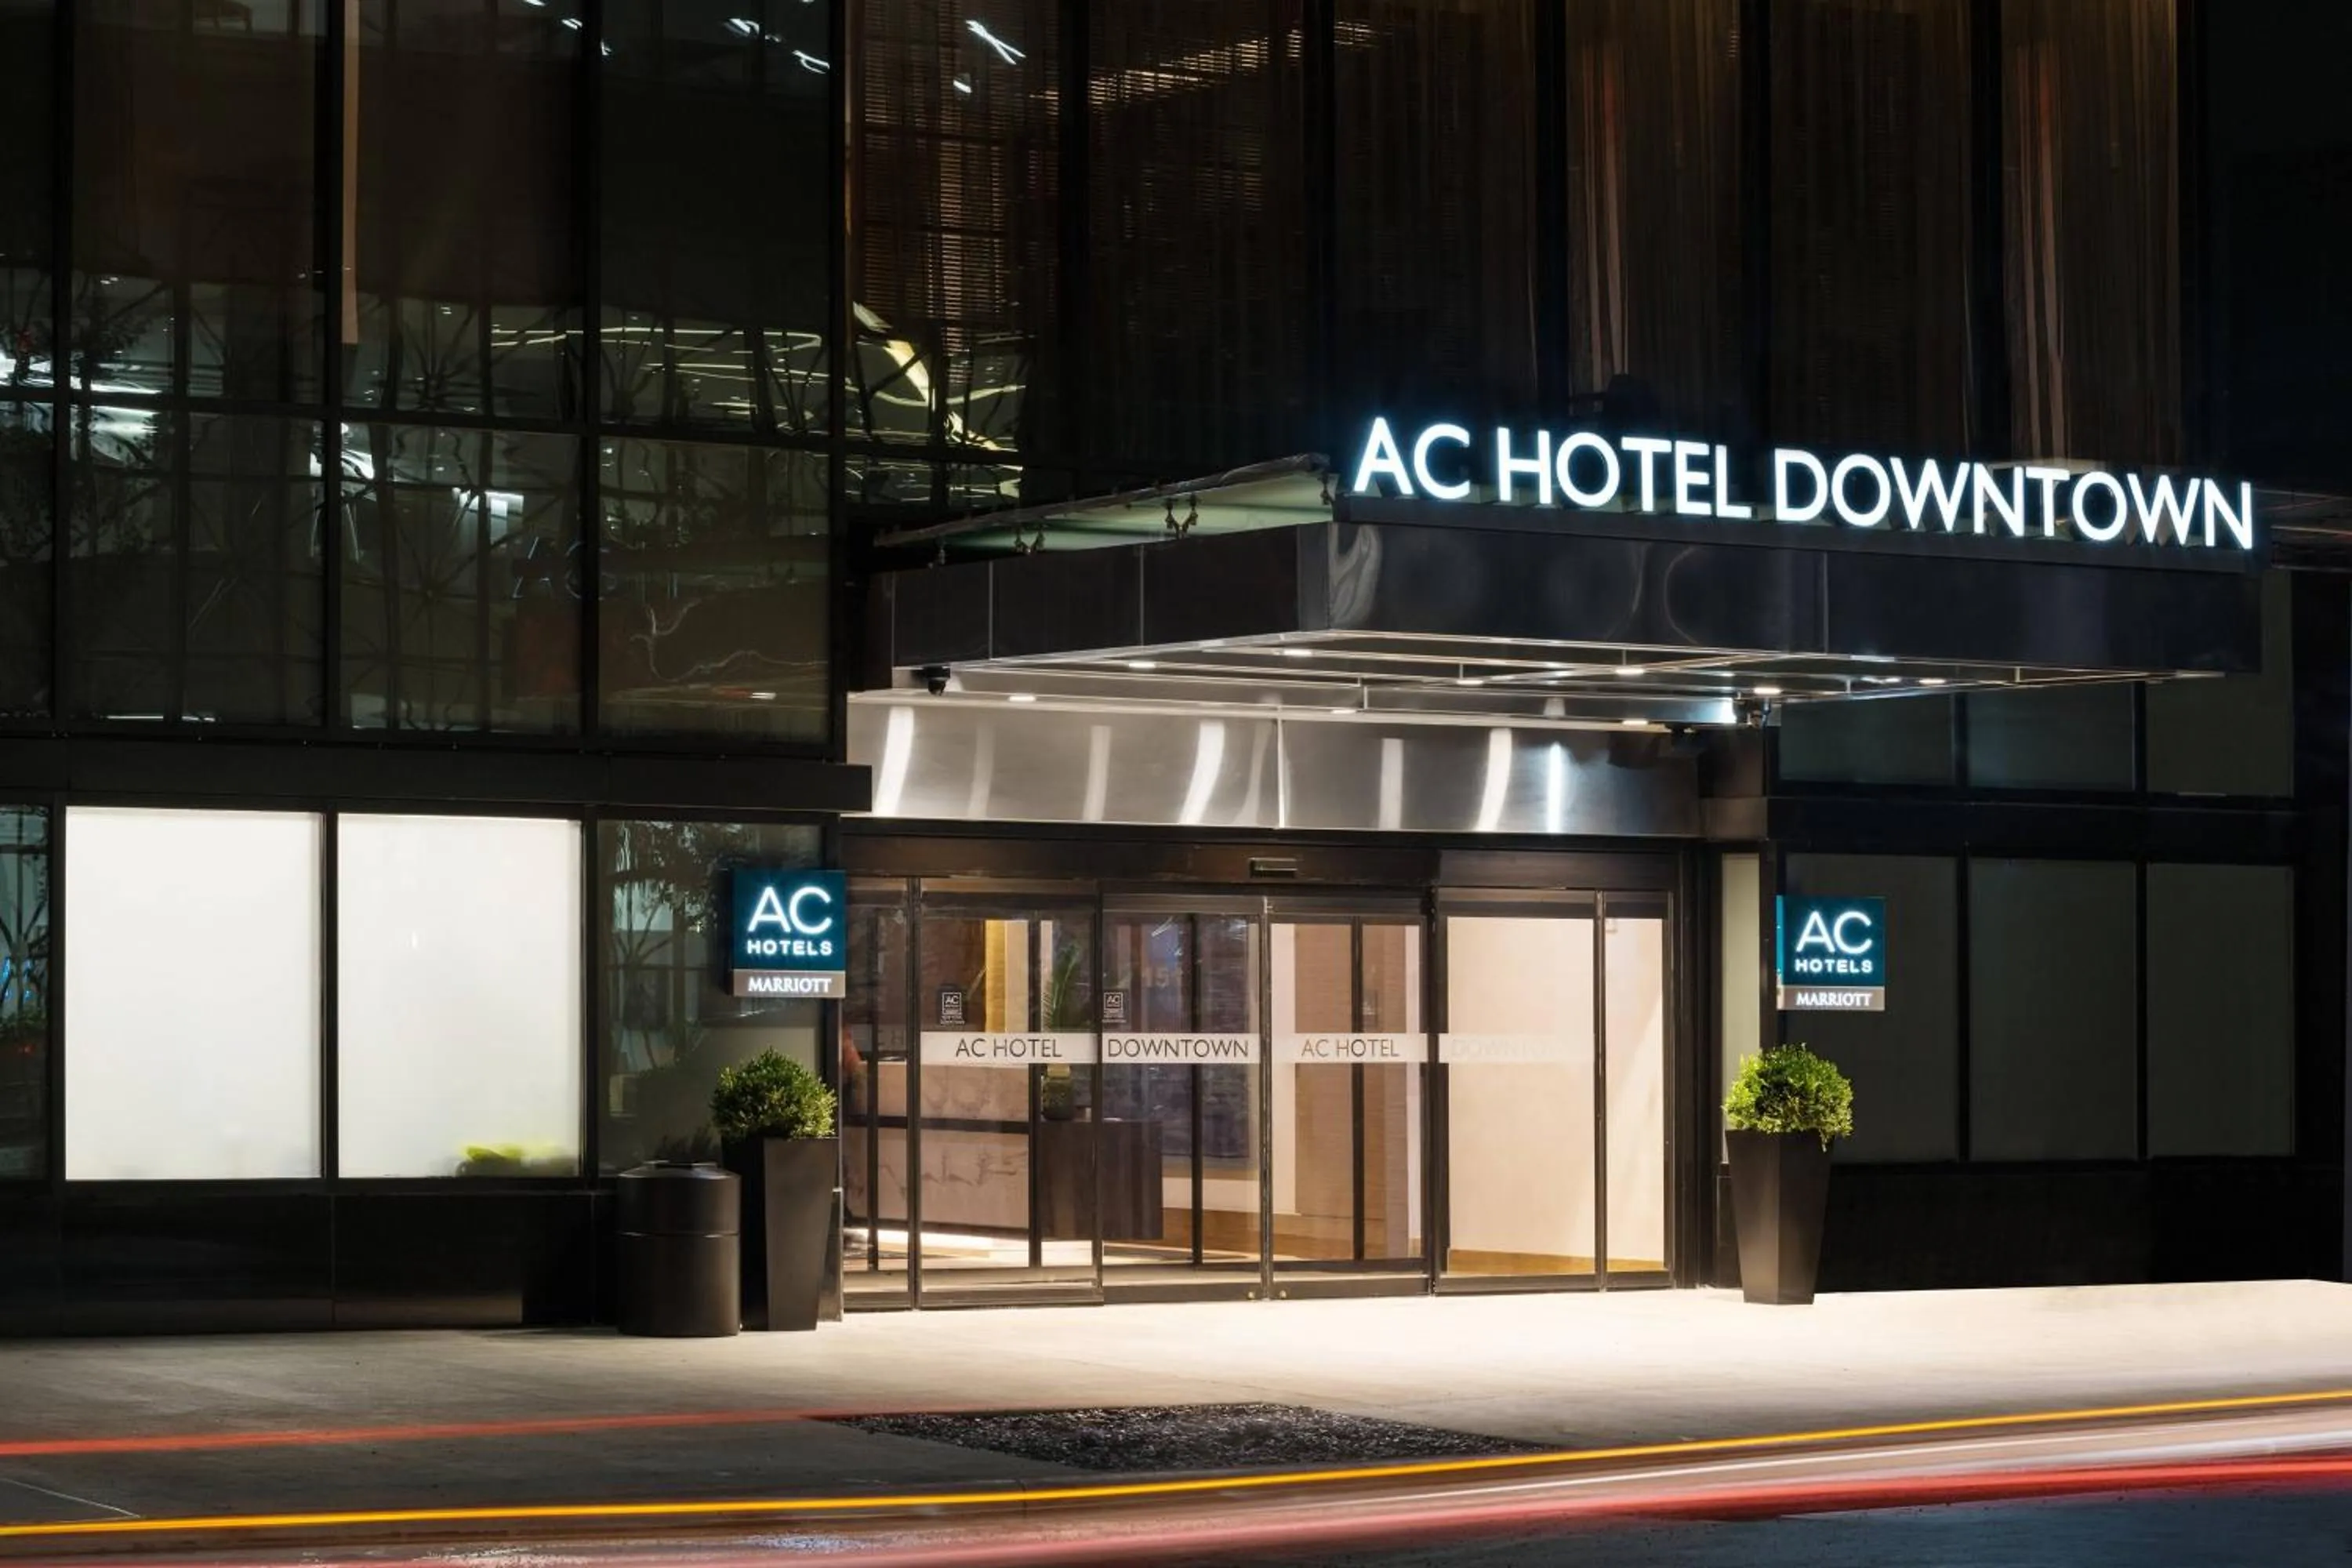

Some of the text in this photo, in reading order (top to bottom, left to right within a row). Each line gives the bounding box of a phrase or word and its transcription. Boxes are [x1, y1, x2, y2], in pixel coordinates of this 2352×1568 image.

[1353, 416, 2253, 550] AC HOTEL DOWNTOWN
[747, 886, 833, 935] AC
[1795, 910, 1873, 954] AC
[746, 939, 833, 956] HOTELS
[1795, 959, 1873, 973] HOTELS
[747, 977, 833, 993] MARRIOTT
[1795, 992, 1873, 1006] MARRIOTT
[955, 1037, 1249, 1058] AC HOTEL DOWNTOWN
[1301, 1038, 1559, 1058] AC HOTEL DOWNTO
